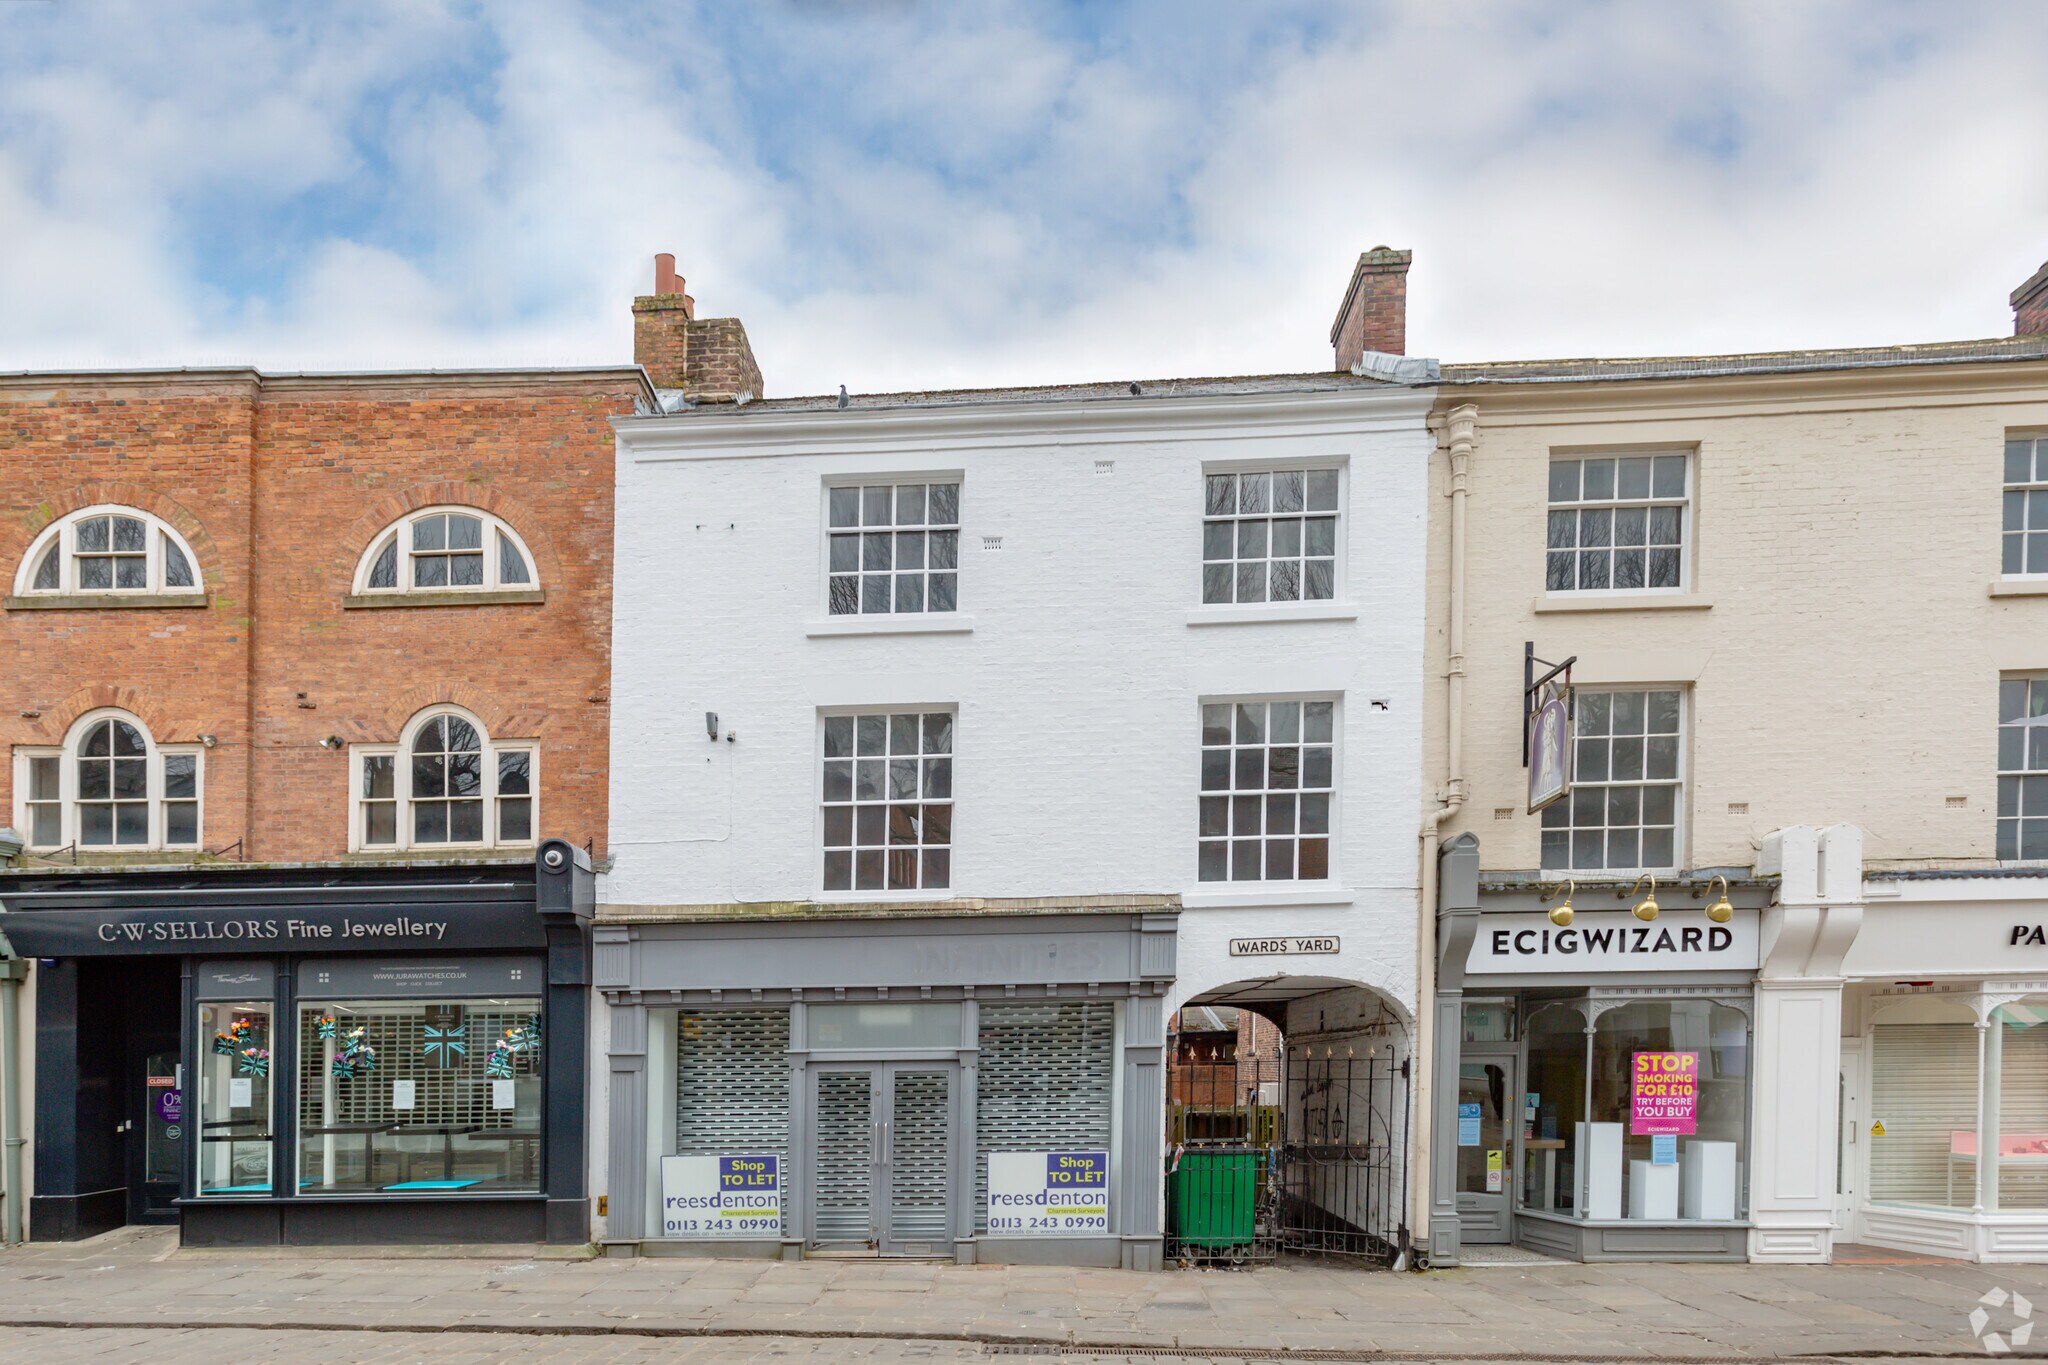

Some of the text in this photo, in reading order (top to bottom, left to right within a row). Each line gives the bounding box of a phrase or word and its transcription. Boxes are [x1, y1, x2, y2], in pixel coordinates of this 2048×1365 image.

[286, 919, 333, 938] Fine
[341, 917, 448, 940] Jewellery
[2009, 924, 2047, 946] PA
[1237, 939, 1333, 953] WARDS YARD
[1492, 926, 1733, 955] ECIGWIZARD
[372, 972, 468, 980] WWW.JURAWATCHES.CO.UK
[1636, 1054, 1694, 1072] STOP
[1637, 1073, 1692, 1083] SMOKING
[1636, 1084, 1693, 1096] FOR £10
[1636, 1097, 1693, 1106] TRY BEFORE
[1636, 1106, 1693, 1117] YOU BUY
[731, 1159, 765, 1173] Shop
[1059, 1156, 1094, 1170] Shop
[722, 1173, 775, 1186] TO LET
[1049, 1171, 1104, 1183] TO LET
[666, 1191, 778, 1208] reesdenton
[991, 1188, 1106, 1206] reesdenton
[721, 1209, 778, 1217] Chartered Surveyors
[666, 1218, 779, 1231] 0113 243 0990
[990, 1216, 1106, 1228] 0113 243 0990
